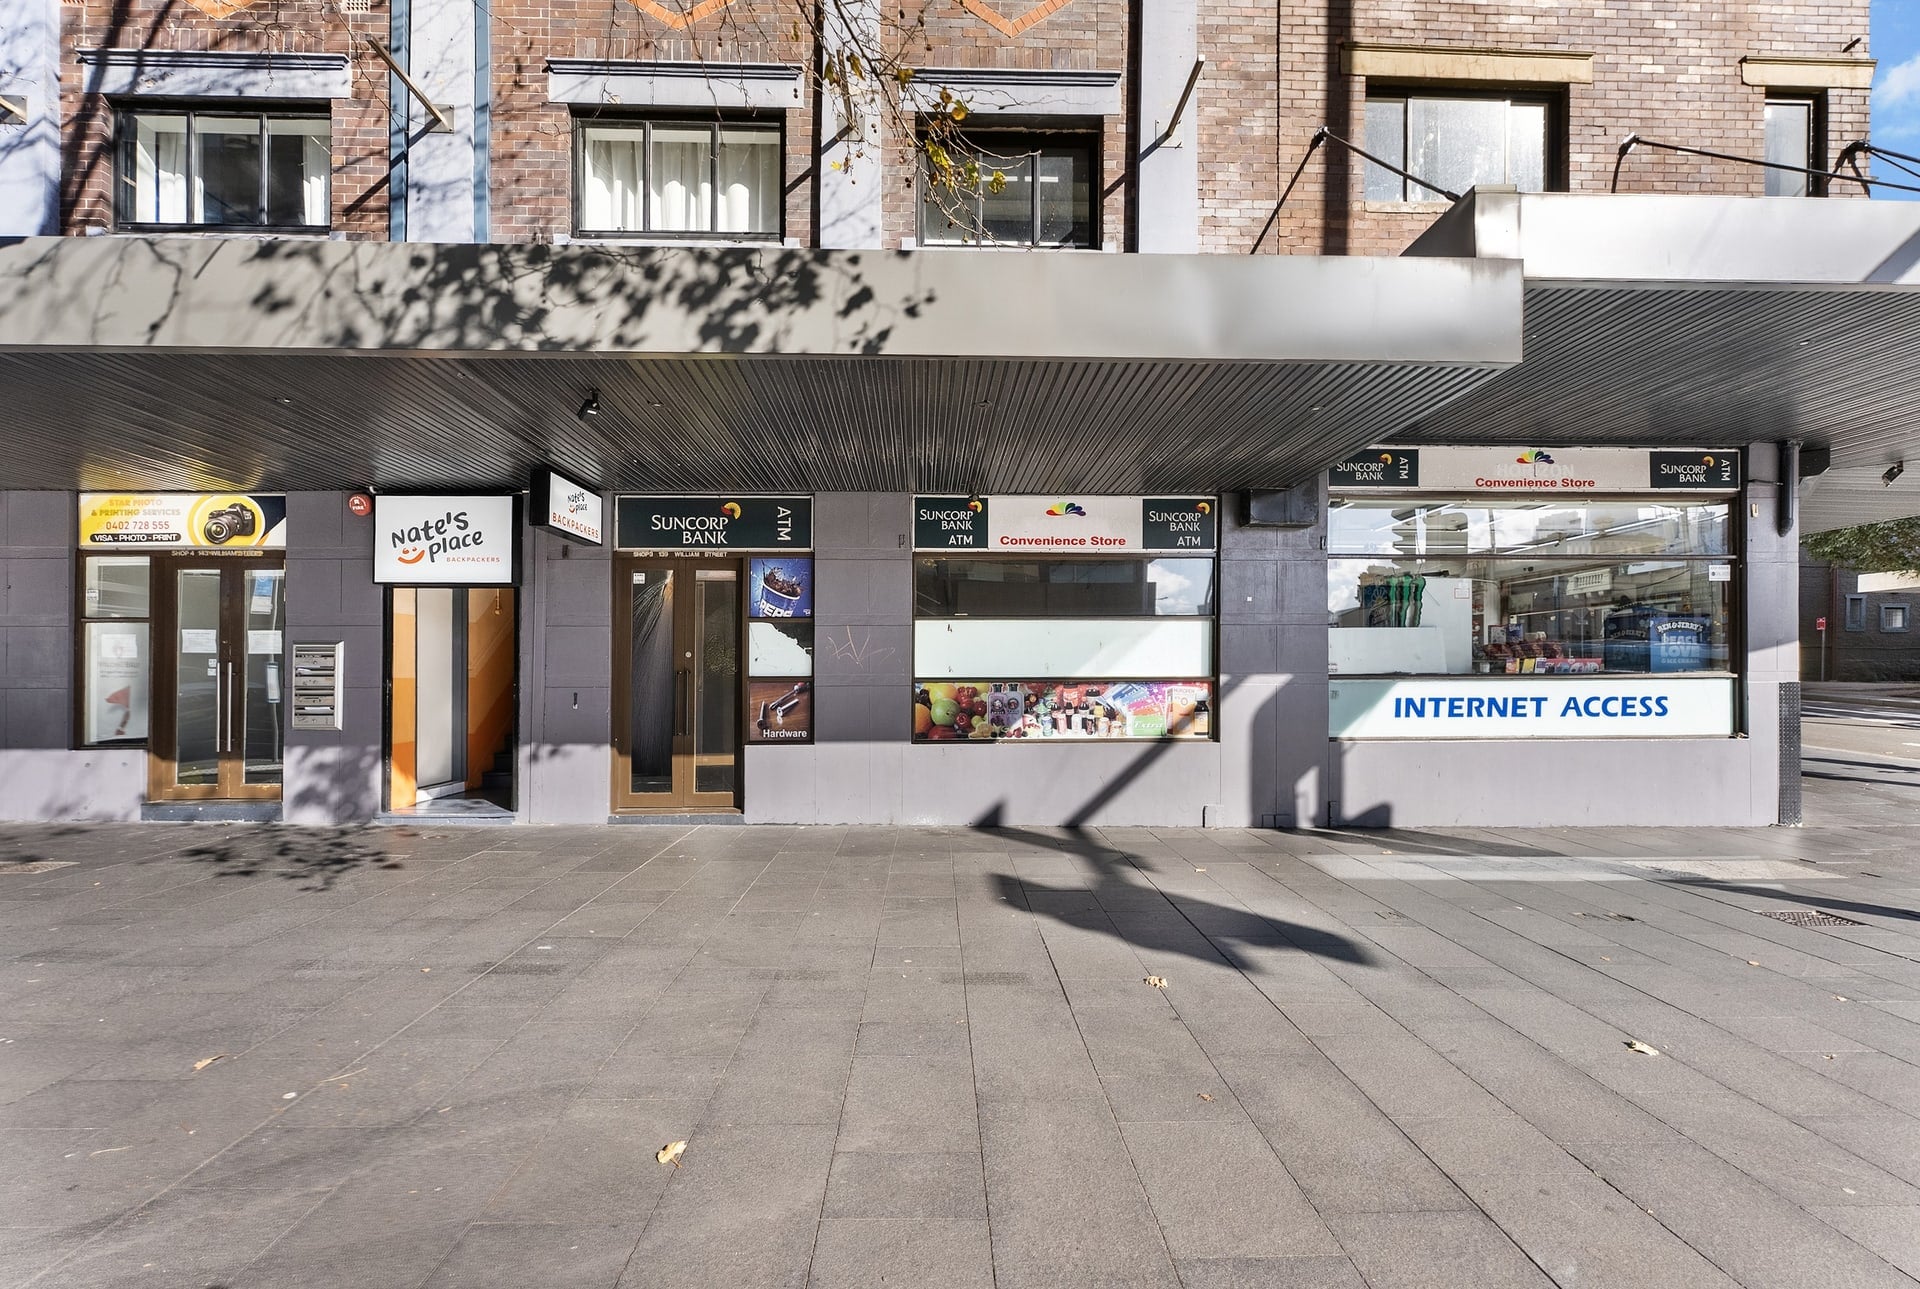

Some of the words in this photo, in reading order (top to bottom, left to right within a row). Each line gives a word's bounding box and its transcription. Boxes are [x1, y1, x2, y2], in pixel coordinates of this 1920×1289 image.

[1337, 461, 1384, 472] SUNCORP
[1399, 456, 1408, 479] ATM
[1660, 463, 1707, 474] SUNCORP
[1721, 459, 1731, 481] ATM
[1355, 471, 1384, 480] BANK
[1679, 474, 1706, 482] BANK
[1475, 478, 1557, 487] Convenience
[1561, 478, 1595, 487] Store
[919, 509, 974, 521] SUNCORP
[1148, 510, 1202, 522] SUNCORP
[105, 521, 129, 530] 0402
[132, 521, 149, 530] 728
[152, 521, 170, 530] 555
[552, 512, 599, 539] BACKPACKERS
[651, 514, 729, 530] SUNCORP
[777, 506, 792, 541] ATM
[941, 521, 973, 530] BANK
[1169, 522, 1201, 532] BANK
[94, 534, 114, 542] VISA
[119, 534, 147, 542] PHOTO
[153, 533, 177, 541] PRINT
[682, 531, 728, 544] BANK
[948, 535, 973, 545] ATM
[1000, 536, 1086, 546] Convenience
[1090, 536, 1126, 546] Store
[1176, 536, 1201, 546] ATM
[1661, 645, 1700, 657] LOVE
[1394, 697, 1548, 718] INTERNET
[1560, 696, 1669, 718] ACCESS
[763, 729, 808, 738] Hardware
